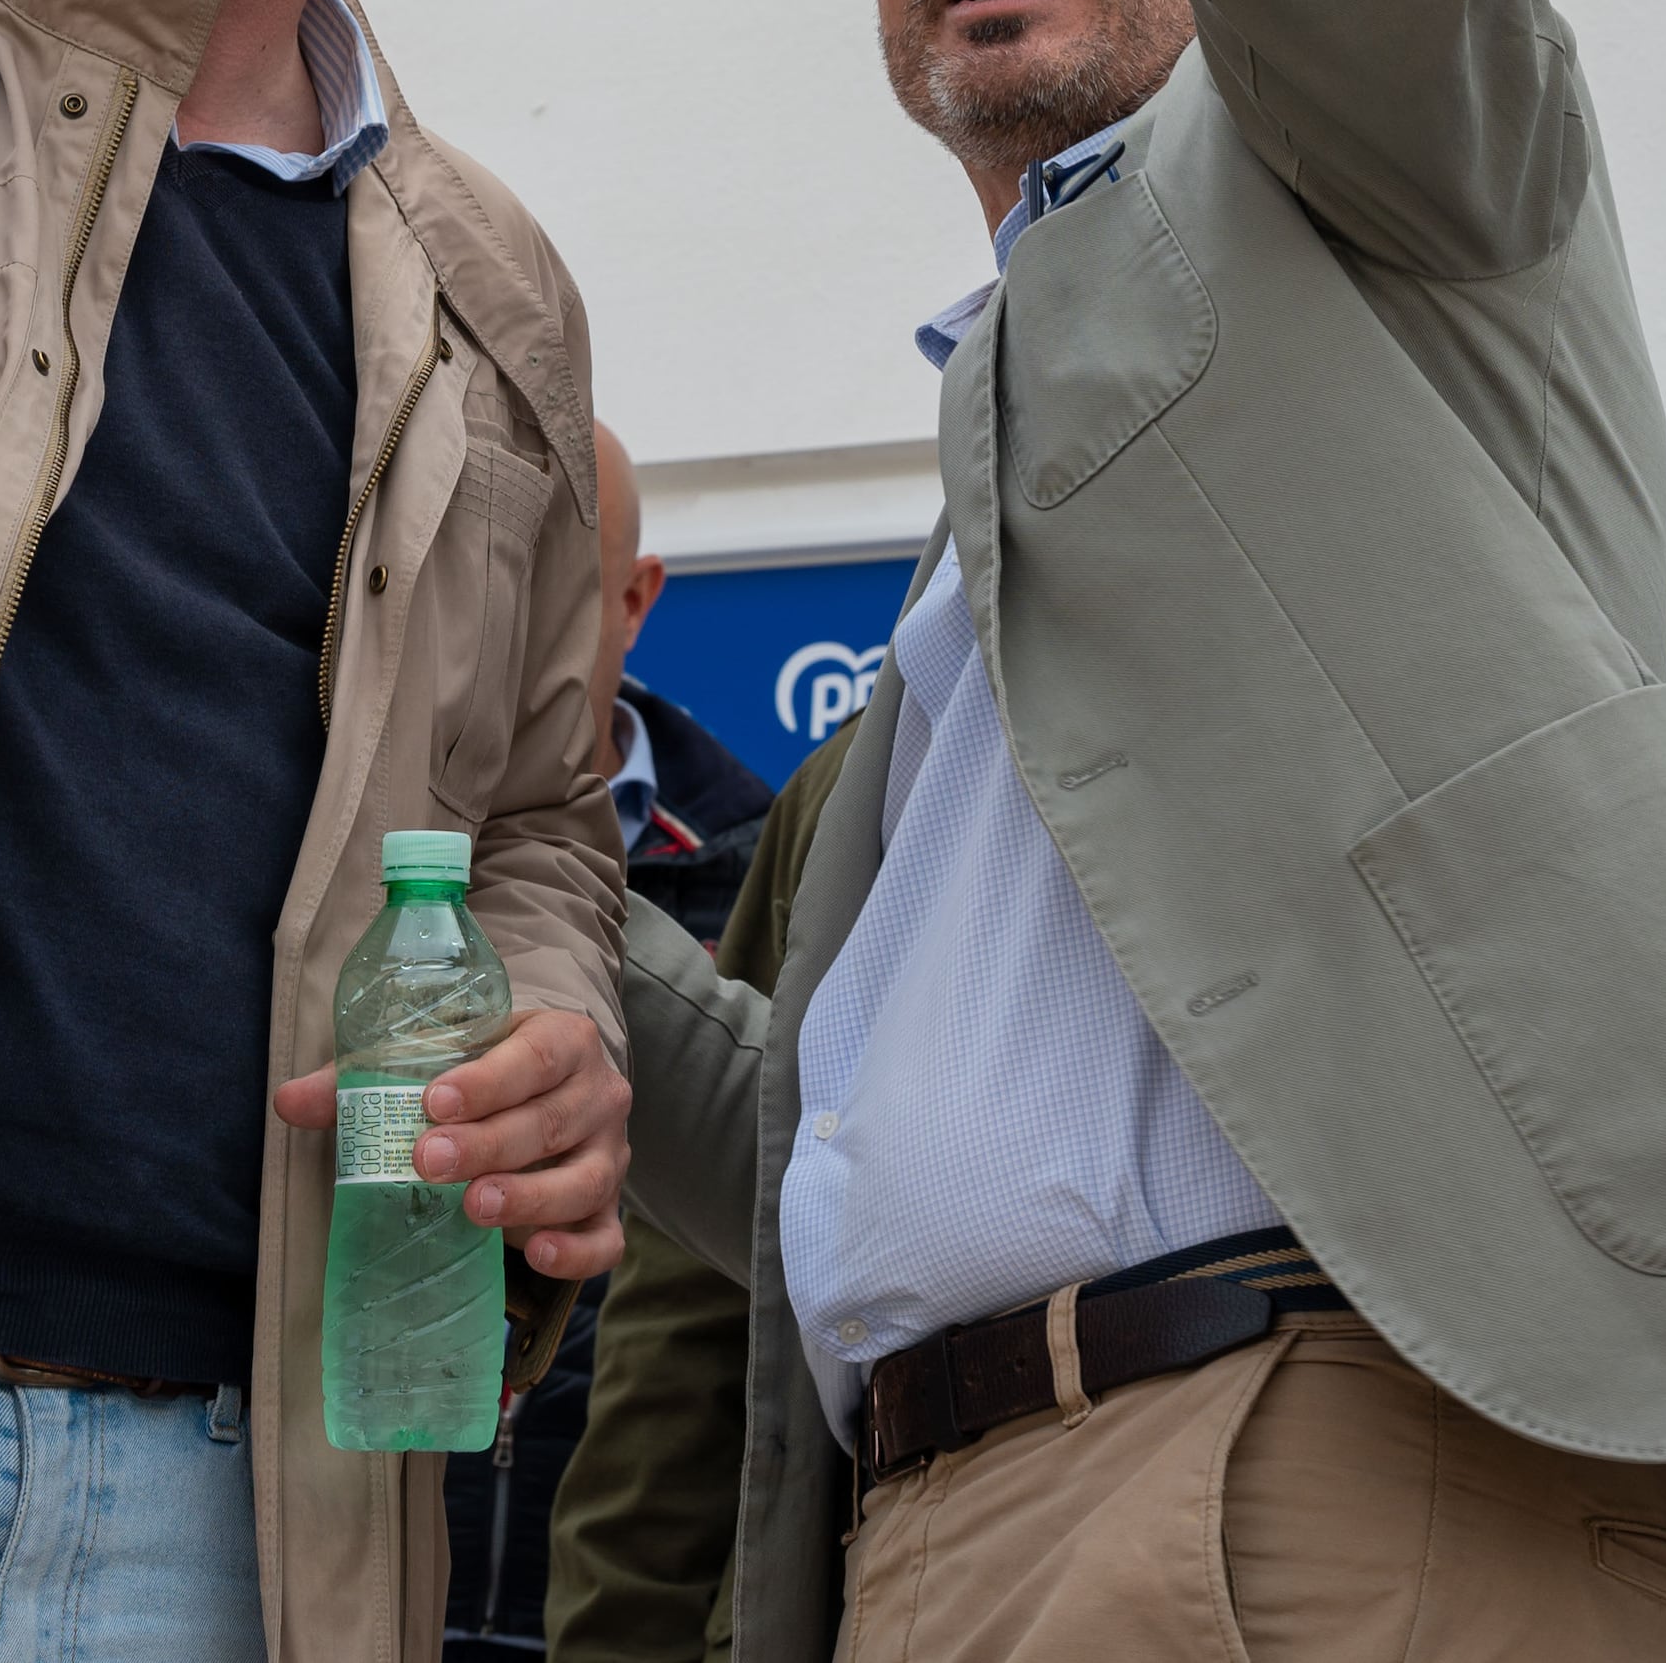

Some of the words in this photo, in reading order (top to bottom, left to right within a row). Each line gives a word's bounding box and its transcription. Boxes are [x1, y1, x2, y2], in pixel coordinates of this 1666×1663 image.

[356, 1092, 382, 1138] Arca
[337, 1105, 356, 1177] Fuente
[355, 1144, 382, 1175] del
